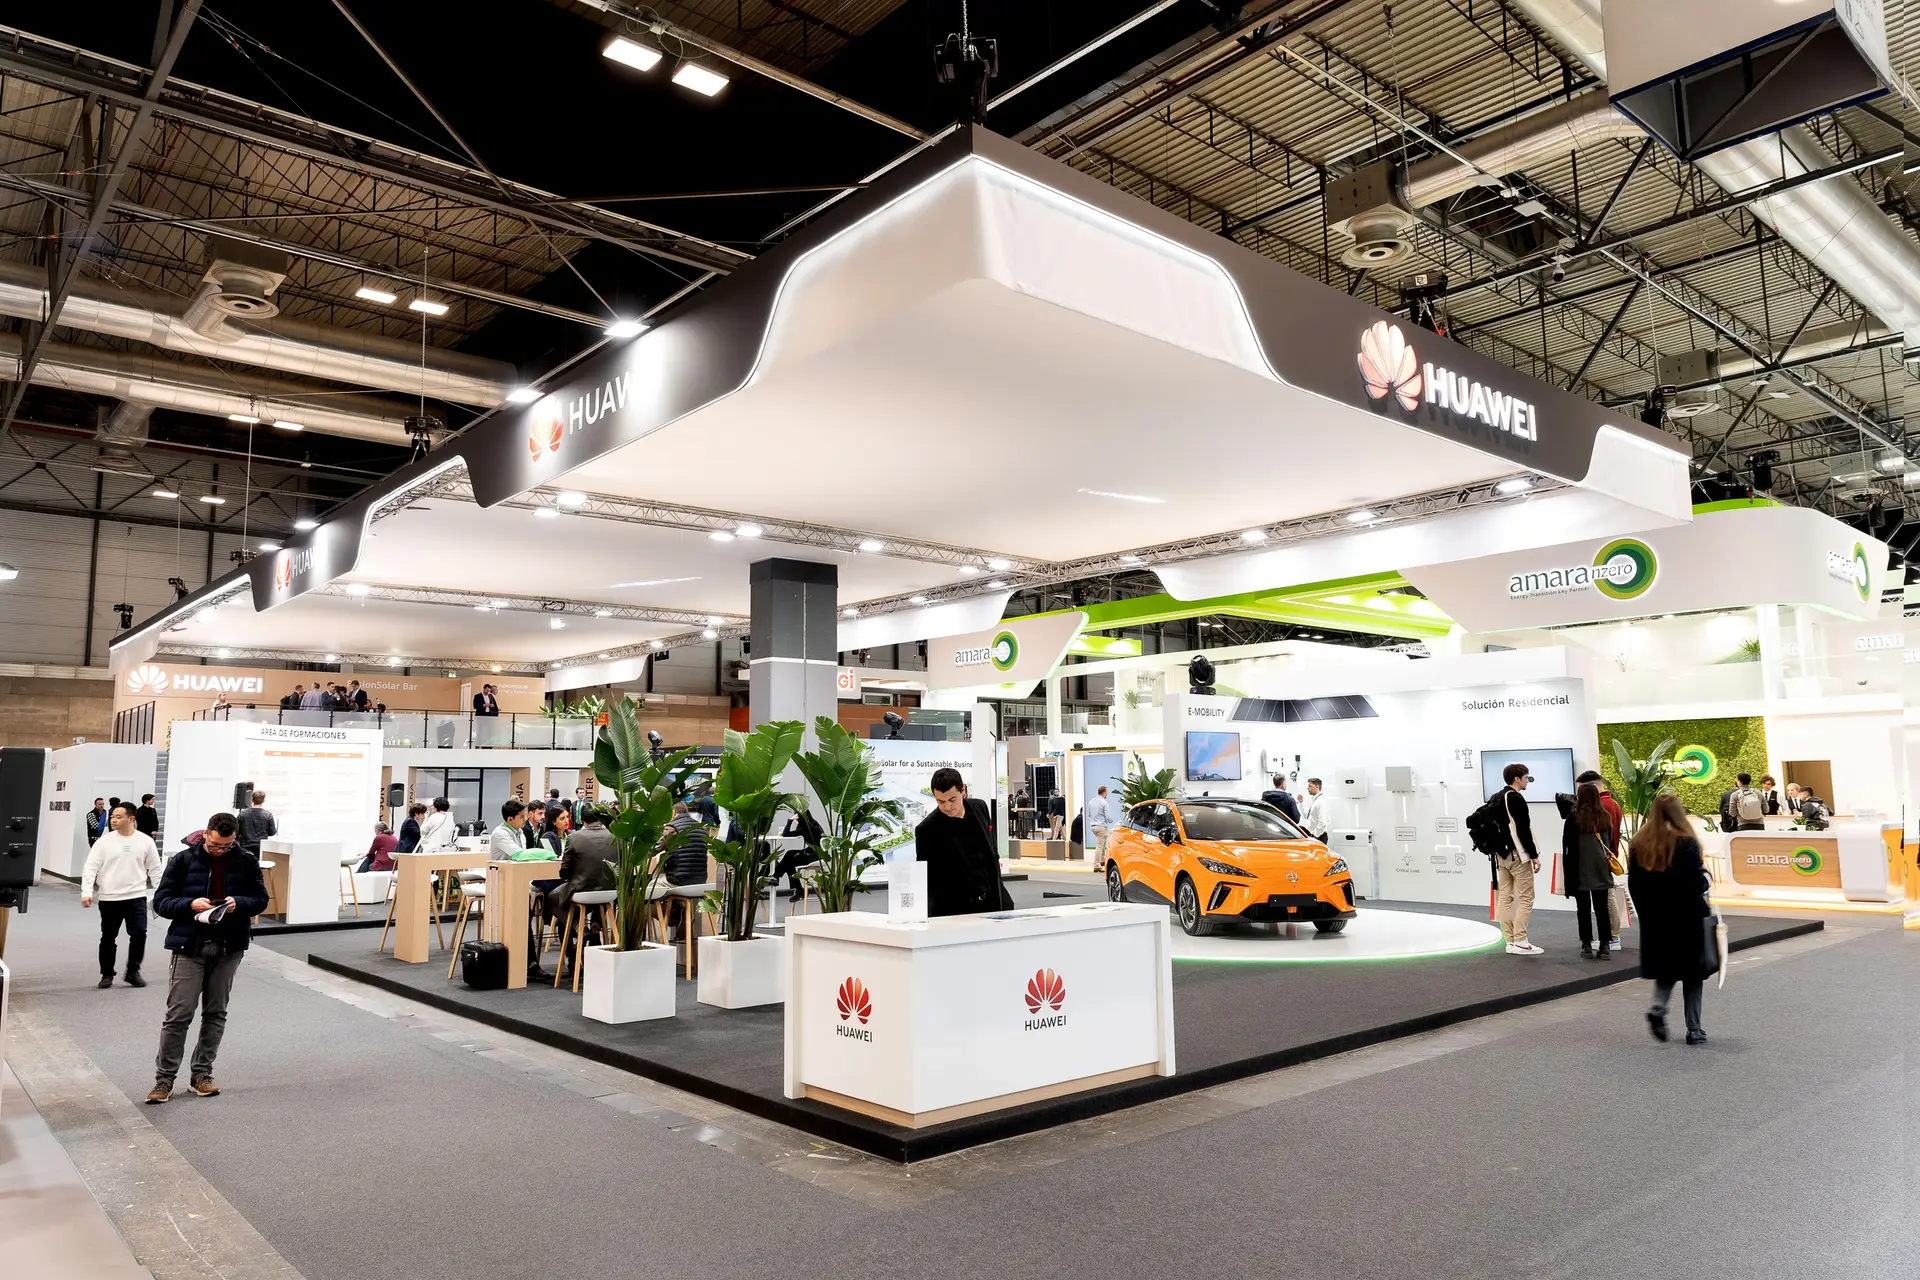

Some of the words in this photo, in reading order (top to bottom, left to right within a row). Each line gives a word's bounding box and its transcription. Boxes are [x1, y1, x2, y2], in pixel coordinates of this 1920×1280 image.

[1423, 362, 1538, 442] HUAWEI
[1509, 566, 1589, 593] amara
[1591, 563, 1633, 579] nzero
[955, 647, 990, 663] amara
[173, 674, 263, 693] HUAWEI
[346, 679, 400, 690] FsionSolar
[402, 682, 418, 691] Bar
[1462, 698, 1505, 711] Solución
[1508, 694, 1570, 708] Residencial
[1188, 707, 1225, 717] E-MOBILITY
[279, 729, 288, 737] DE
[290, 729, 347, 740] FORMACIONES
[899, 759, 909, 767] for
[916, 759, 953, 768] Sustainable
[1746, 854, 1790, 865] amara
[1024, 1015, 1067, 1032] HUAWEI
[836, 1024, 873, 1043] HUAWEI
